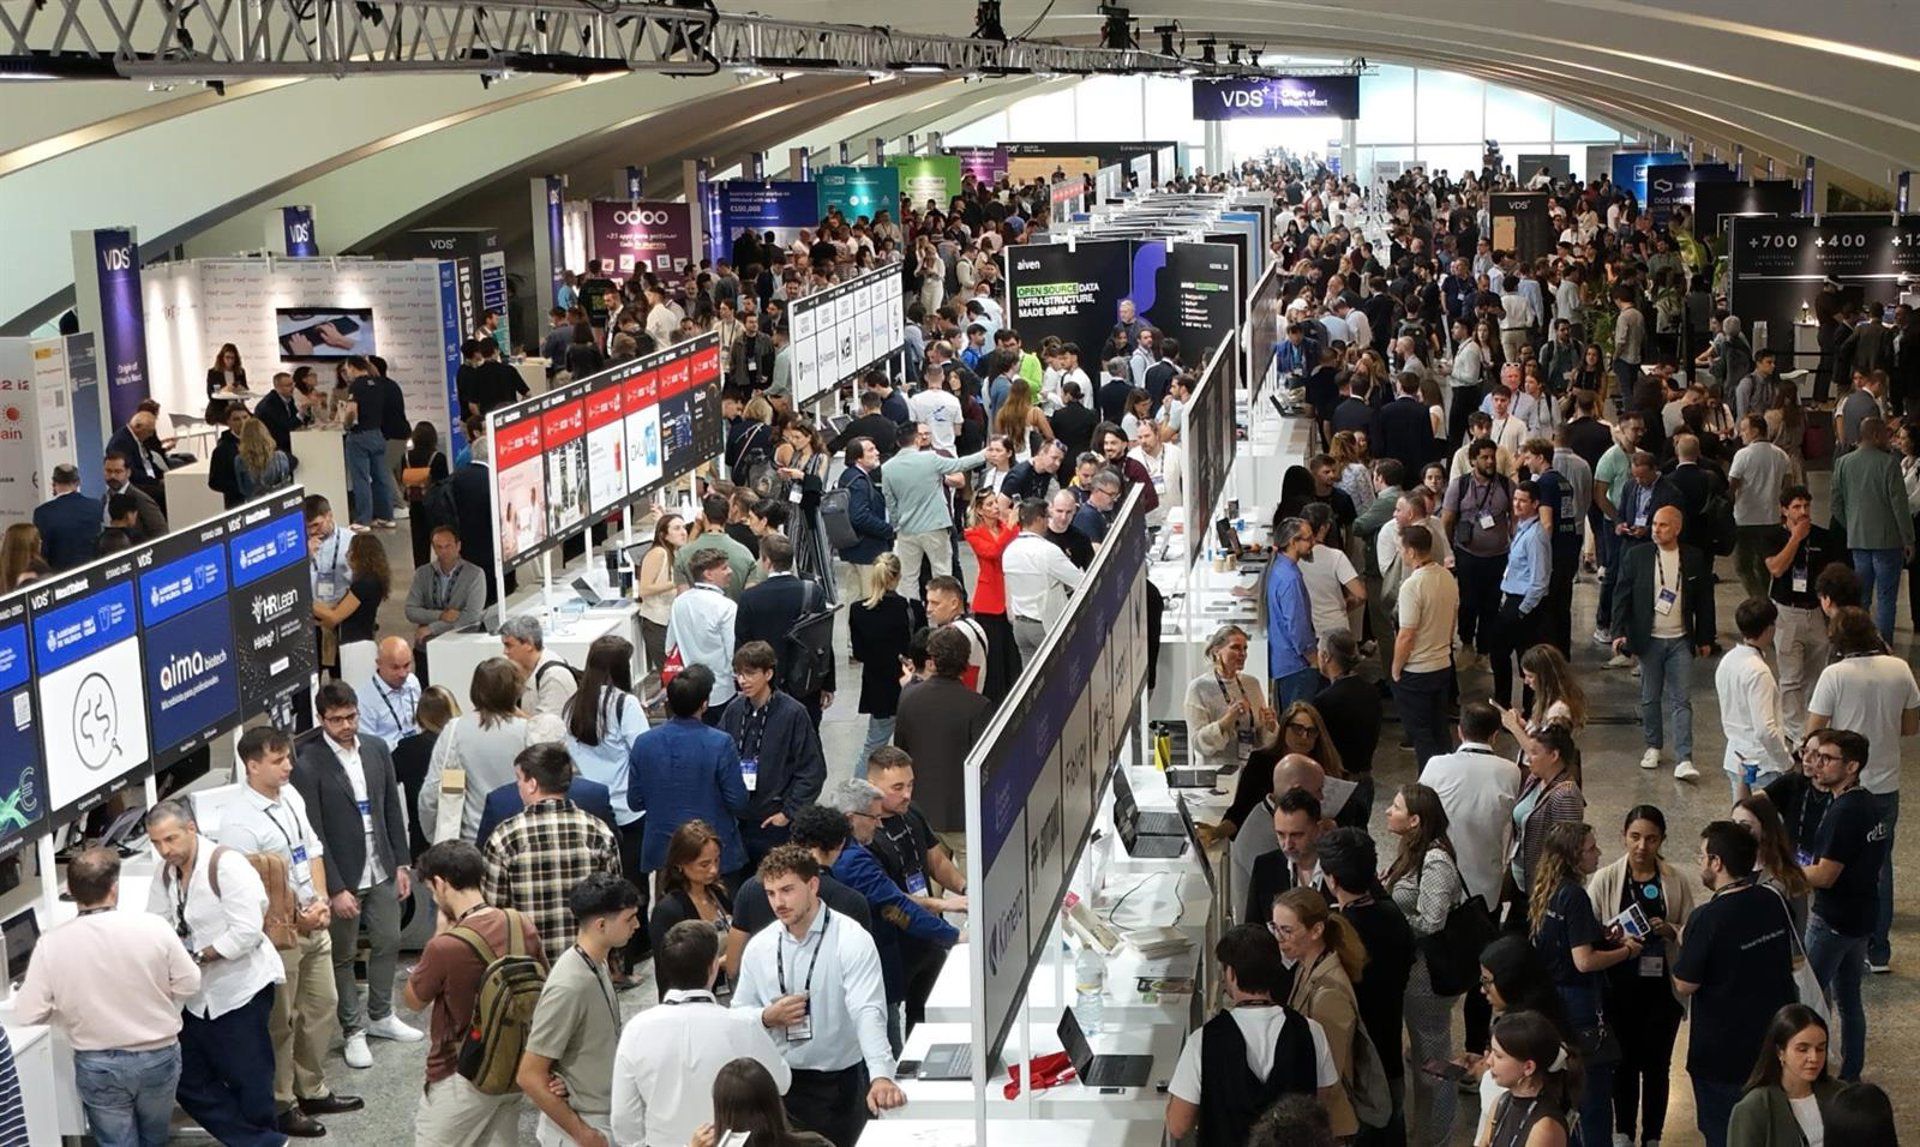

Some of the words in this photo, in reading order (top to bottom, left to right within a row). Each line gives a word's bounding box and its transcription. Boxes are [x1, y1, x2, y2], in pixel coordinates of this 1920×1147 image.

[1309, 98, 1328, 107] Next
[614, 205, 668, 225] odoo
[1749, 234, 1798, 248] +700
[1814, 234, 1866, 248] +400
[1017, 259, 1041, 271] aiven
[1018, 286, 1042, 296] OPEN
[1043, 284, 1078, 294] SOURCE
[1079, 282, 1100, 293] DATA
[1018, 293, 1096, 308] INFRASTRUCTURE,
[1018, 306, 1045, 319] MADE
[1045, 305, 1079, 317] SIMPLE.
[160, 651, 204, 691] aima
